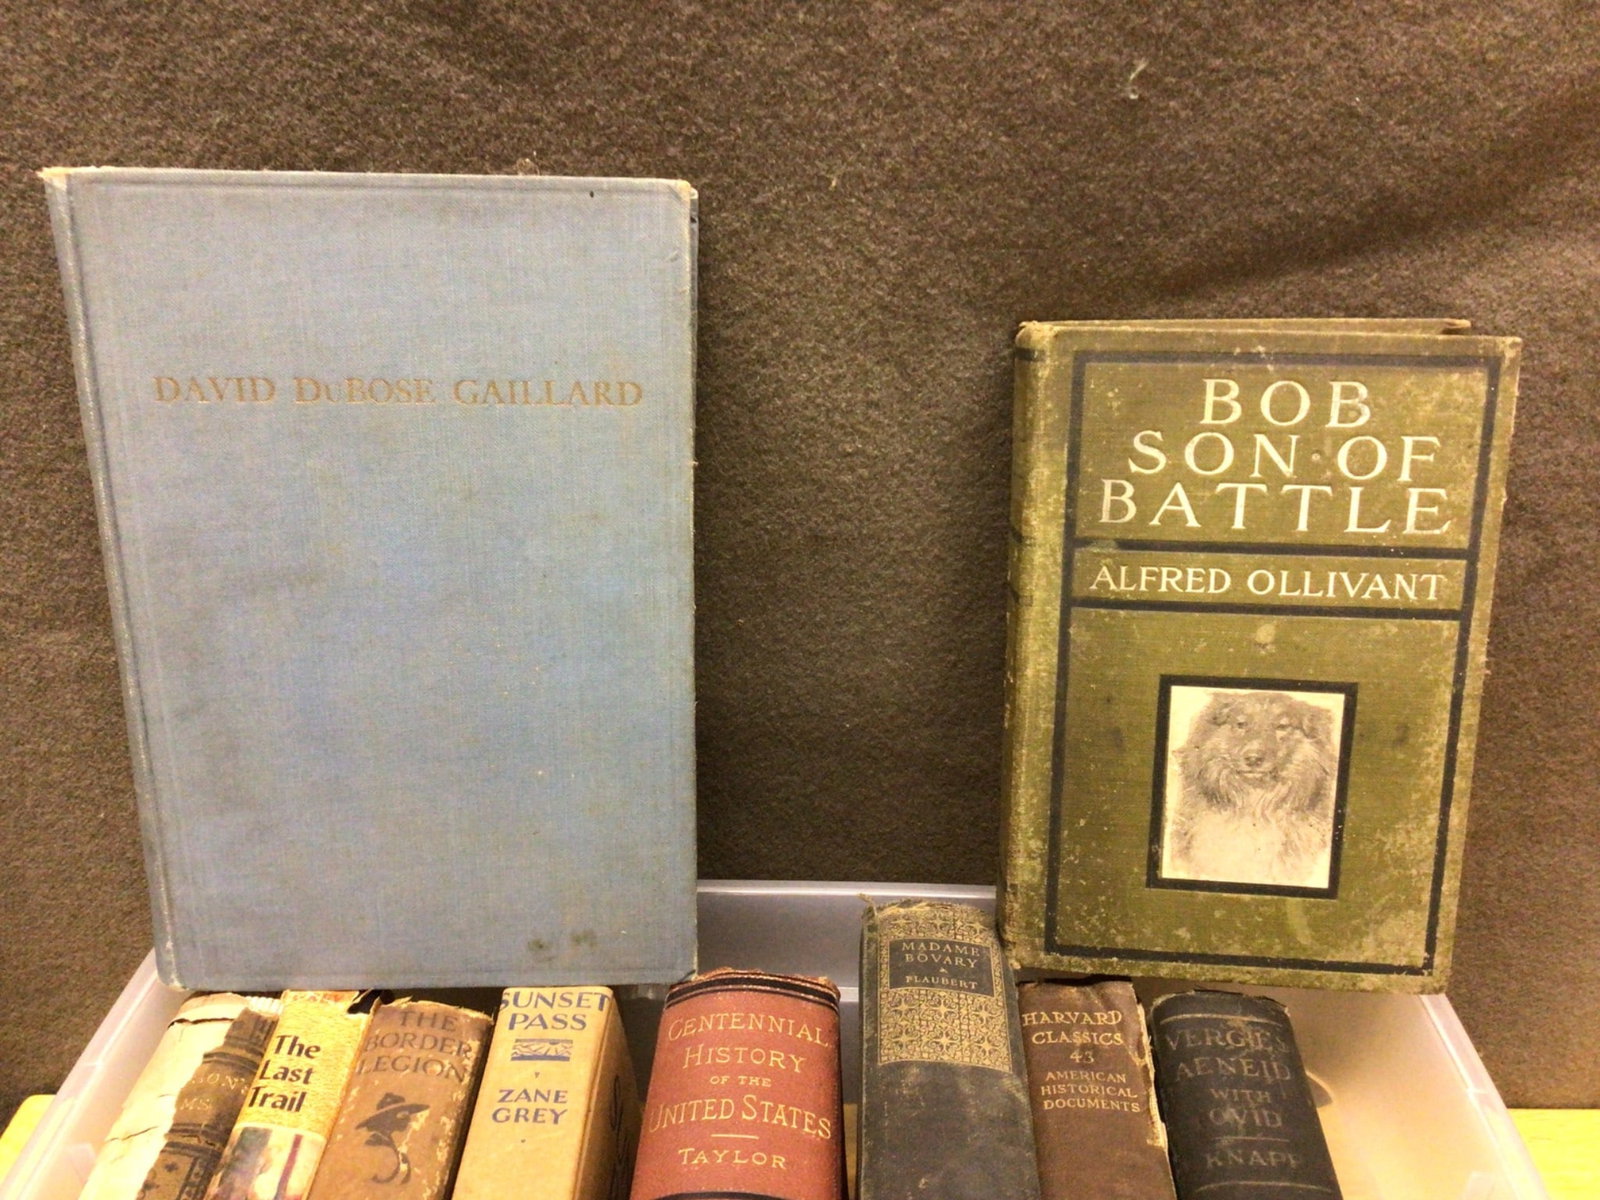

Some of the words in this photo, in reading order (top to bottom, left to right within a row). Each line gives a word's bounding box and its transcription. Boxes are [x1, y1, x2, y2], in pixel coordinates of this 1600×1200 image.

[153, 376, 275, 403] DAVID
[453, 378, 643, 407] GAILLARD
[1200, 378, 1372, 428] BOB
[1128, 430, 1300, 478] SON
[1337, 435, 1441, 482] OF
[1098, 478, 1452, 535] BATTLE
[1089, 565, 1232, 595] ALFRED
[1247, 569, 1444, 602] OLLIVANT
[902, 941, 980, 957] MADAME
[905, 953, 977, 969] BOVARY
[905, 975, 978, 990] FLAUBERT
[500, 990, 611, 1012] SUNSET
[400, 1009, 458, 1032] THE
[508, 1012, 587, 1031] PASS
[1022, 1009, 1122, 1027] HARVARD
[668, 1012, 829, 1047] CENTENNIAL
[1031, 1030, 1125, 1046] CLASSICS
[274, 1034, 321, 1060] The
[364, 1031, 473, 1060] BORDER
[1069, 1047, 1095, 1063] 43
[357, 1054, 468, 1083] LEGION
[682, 1042, 807, 1073] HISTORY
[258, 1059, 315, 1085] Last
[1044, 1069, 1127, 1084] AMERICAN
[1175, 1055, 1292, 1083] AENEID
[710, 1075, 730, 1086] OF
[738, 1075, 772, 1088] THE
[1041, 1083, 1138, 1098] HISTORICAL
[248, 1085, 308, 1112] Trail
[497, 1087, 569, 1104] ZANE
[1043, 1098, 1141, 1113] DOCUMENTS
[1210, 1087, 1273, 1104] WITH
[491, 1106, 569, 1126] GREY
[648, 1098, 735, 1133] UNITED
[741, 1094, 832, 1140] STATES
[1208, 1106, 1284, 1129] OVID
[678, 1147, 787, 1169] TAYLOR
